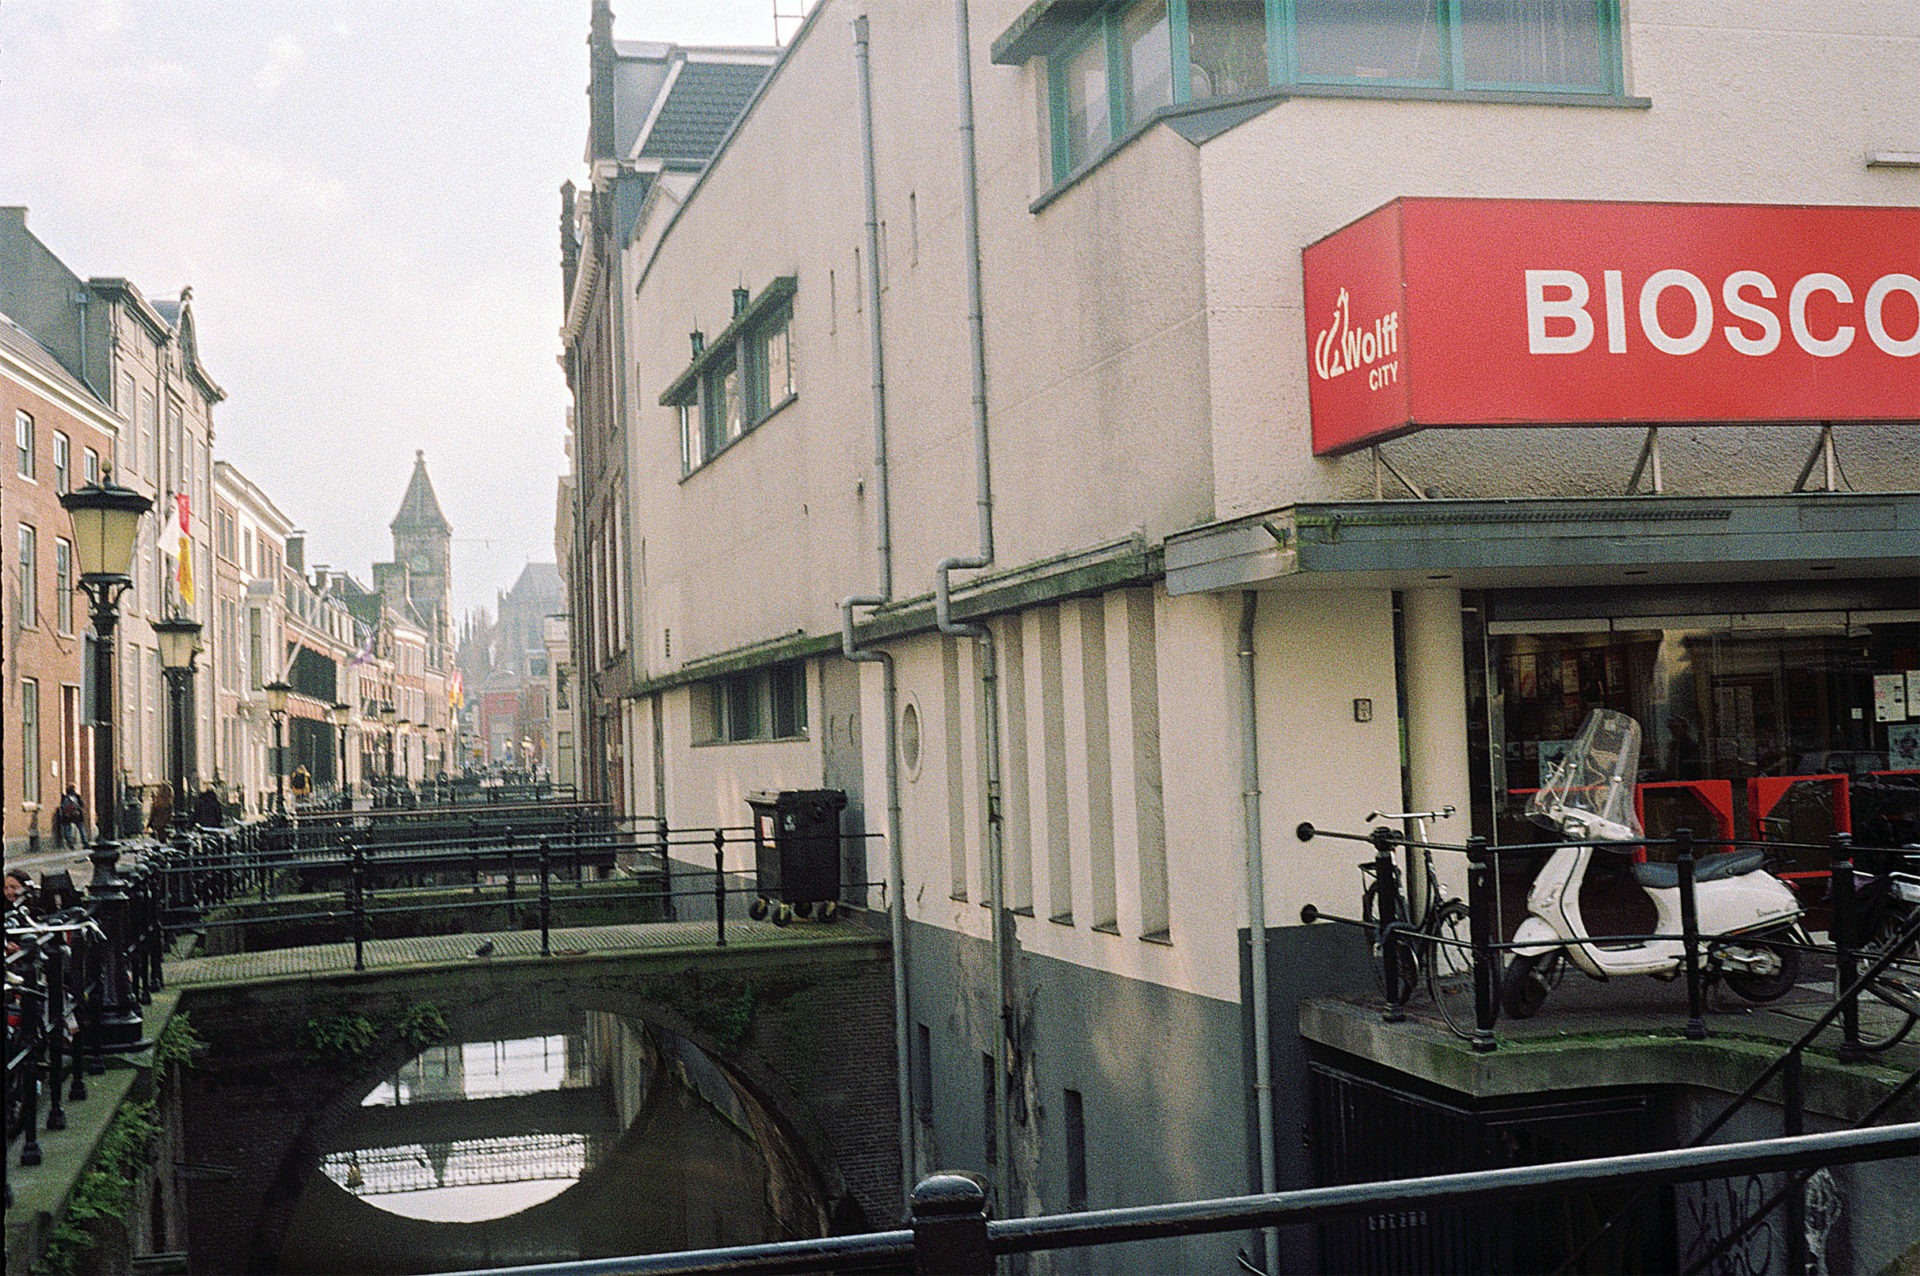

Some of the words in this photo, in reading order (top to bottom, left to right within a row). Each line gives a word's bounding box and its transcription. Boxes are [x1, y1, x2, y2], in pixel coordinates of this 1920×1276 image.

[1341, 310, 1398, 372] Wolff
[1525, 268, 1920, 357] BIOSCO
[1368, 360, 1399, 391] CITY
